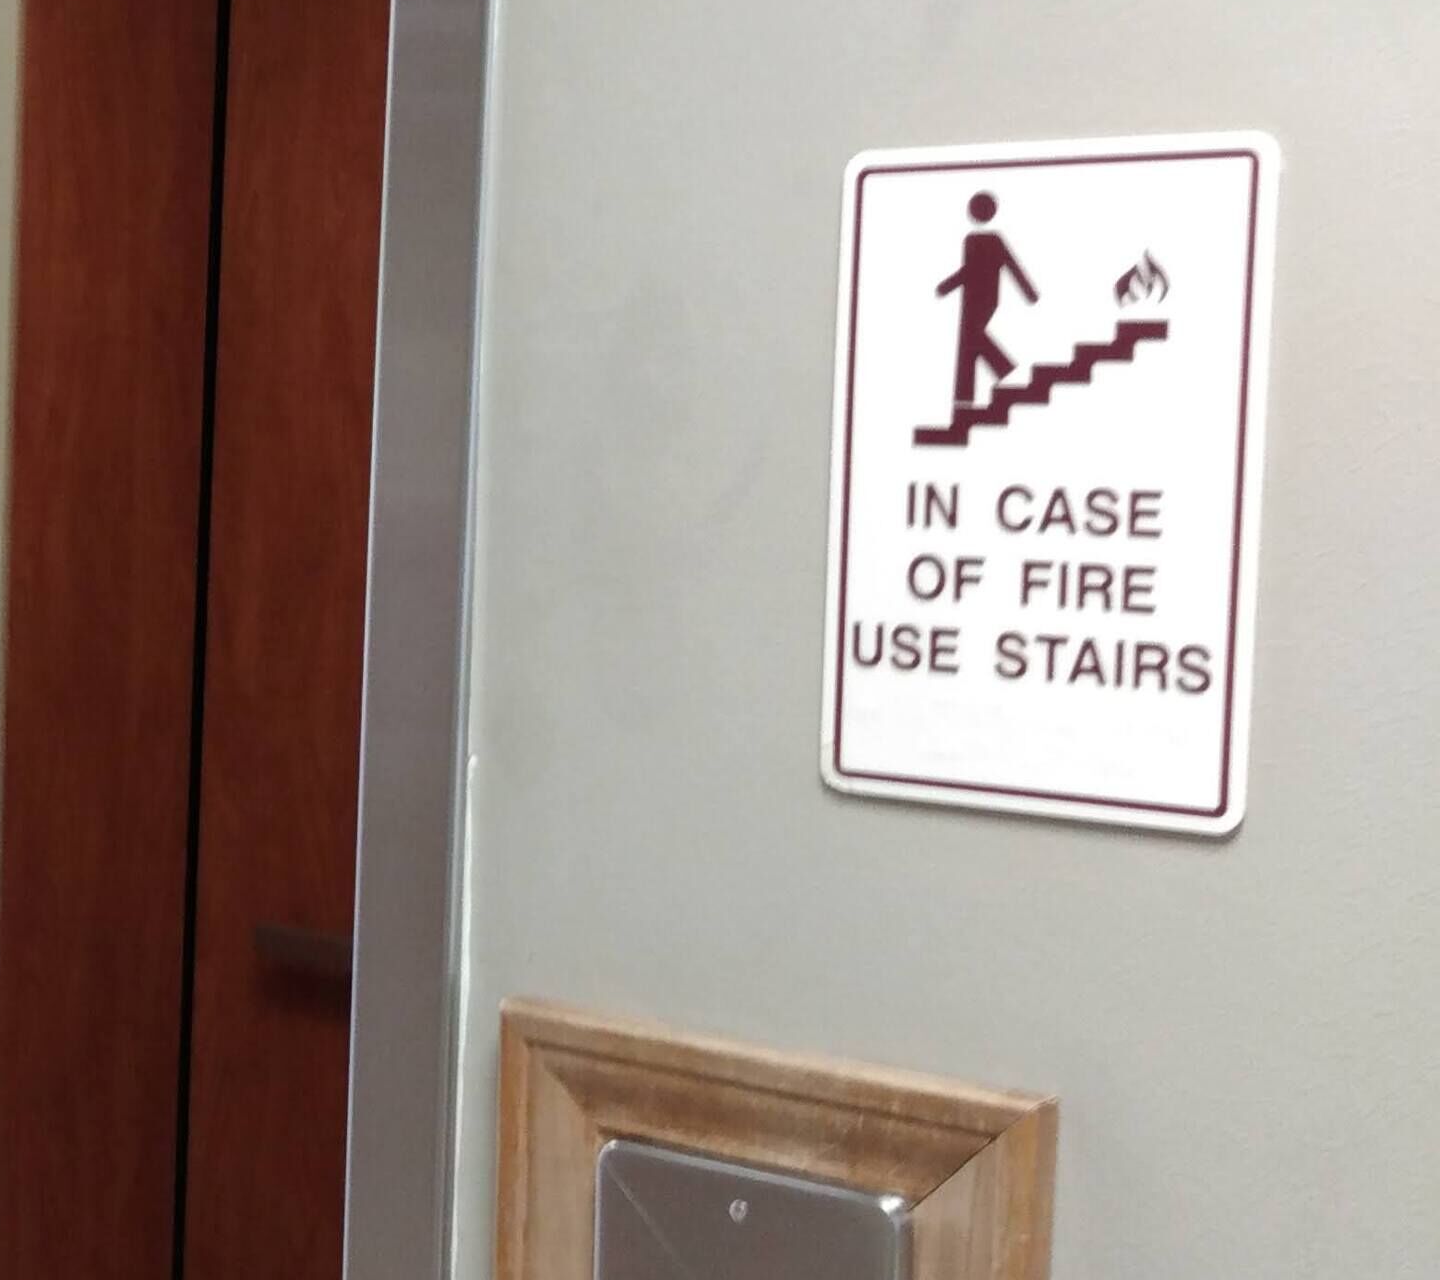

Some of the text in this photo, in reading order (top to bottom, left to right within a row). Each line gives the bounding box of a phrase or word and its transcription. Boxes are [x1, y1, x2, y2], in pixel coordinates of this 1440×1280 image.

[906, 481, 1163, 539] IN CASE
[907, 553, 1157, 614] OF FIRE
[851, 622, 1213, 695] USE STAIRS
